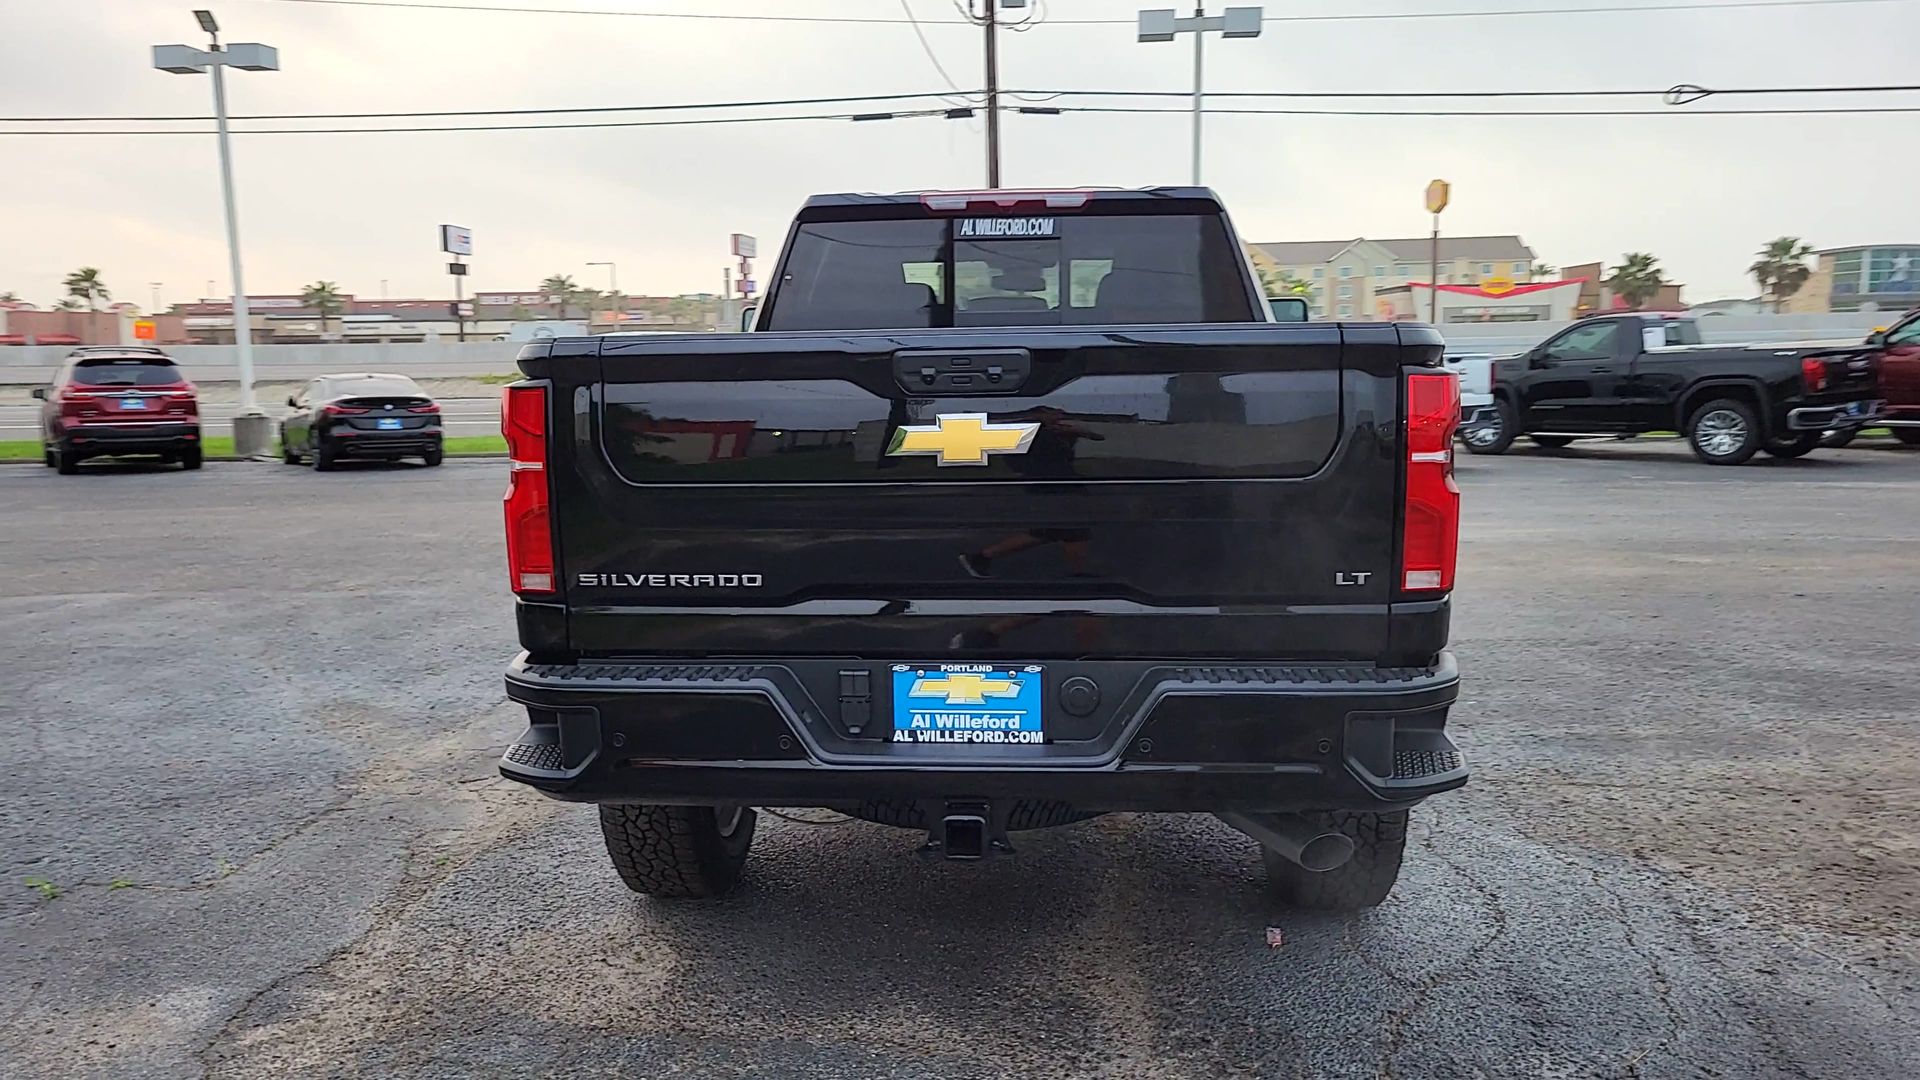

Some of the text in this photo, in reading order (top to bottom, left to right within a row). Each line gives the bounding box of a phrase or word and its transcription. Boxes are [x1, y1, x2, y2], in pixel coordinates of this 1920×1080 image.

[960, 218, 1054, 236] AL WILLEFORD.COM
[578, 573, 763, 587] SILVERADO
[1335, 572, 1372, 585] LT
[940, 664, 993, 673] PORTLAND
[911, 714, 1020, 729] Al Willeford
[893, 730, 1044, 744] AL WILLEFORD.COM
